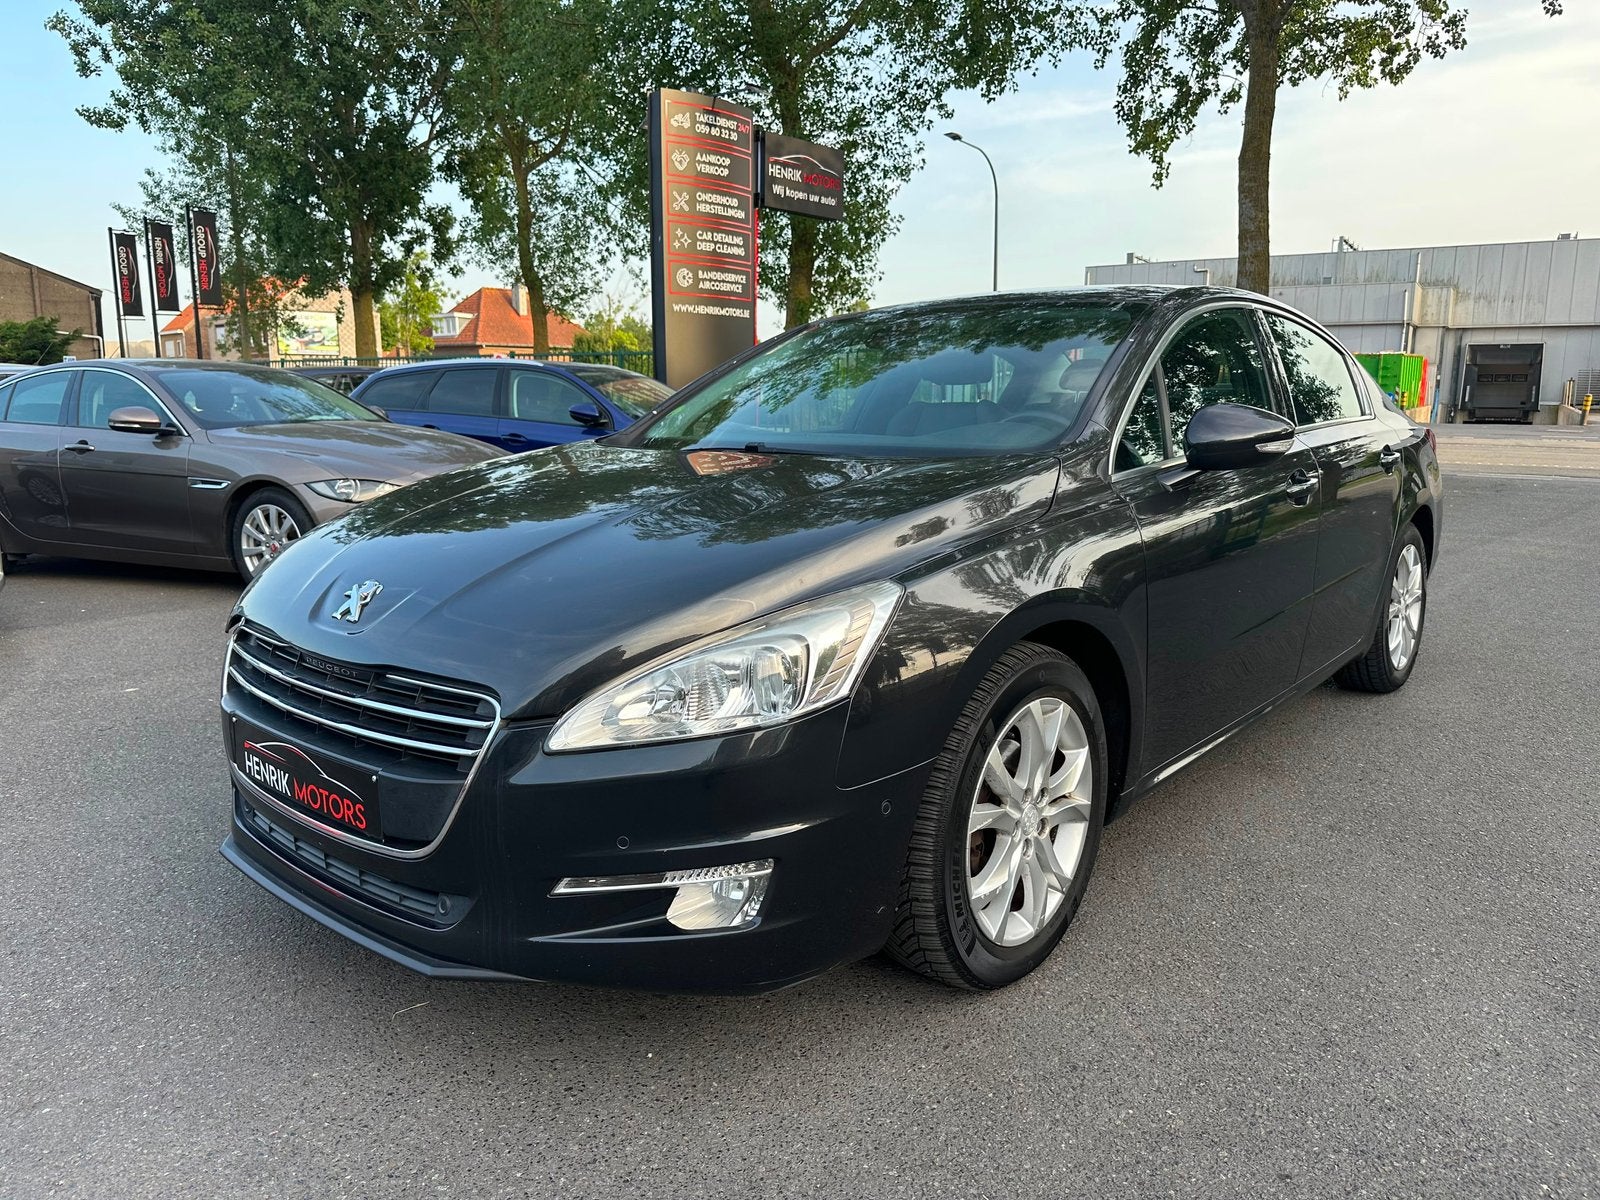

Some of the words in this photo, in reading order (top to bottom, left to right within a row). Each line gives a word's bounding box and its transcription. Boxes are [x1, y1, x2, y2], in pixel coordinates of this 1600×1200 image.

[695, 112, 738, 130] TAKELDIENST
[738, 123, 750, 134] 24/7
[695, 123, 710, 135] 059
[721, 129, 729, 139] 32
[730, 131, 738, 141] 30
[695, 152, 731, 166] AANKOOP
[695, 163, 729, 177] VERKOOP
[768, 163, 802, 182] HENRIK
[803, 172, 842, 192] MOTORS
[695, 192, 739, 207] ONDERHOUD
[772, 184, 784, 198] Wij
[786, 187, 808, 201] kopen
[809, 193, 820, 203] uw
[696, 203, 745, 219] HERSTELLINGEN
[196, 225, 207, 258] GROUP
[696, 230, 712, 241] CAR
[713, 233, 744, 246] DETAILING
[154, 237, 164, 265] HENRIK
[696, 241, 715, 252] DEEP
[716, 244, 745, 256] CLEANING
[118, 246, 128, 275] GROUP
[156, 265, 167, 298] MOTORS
[199, 259, 209, 291] HENRIK
[698, 270, 746, 284] BANDENSERVICE
[121, 276, 131, 304] HENRIK
[698, 281, 742, 293] AIRCOSERVICE
[672, 303, 750, 318] WWW.HENRIKMOTORS.BE
[306, 656, 359, 678] PEUGEOT
[244, 751, 292, 797] HENRIK
[293, 777, 367, 830] MOTORS
